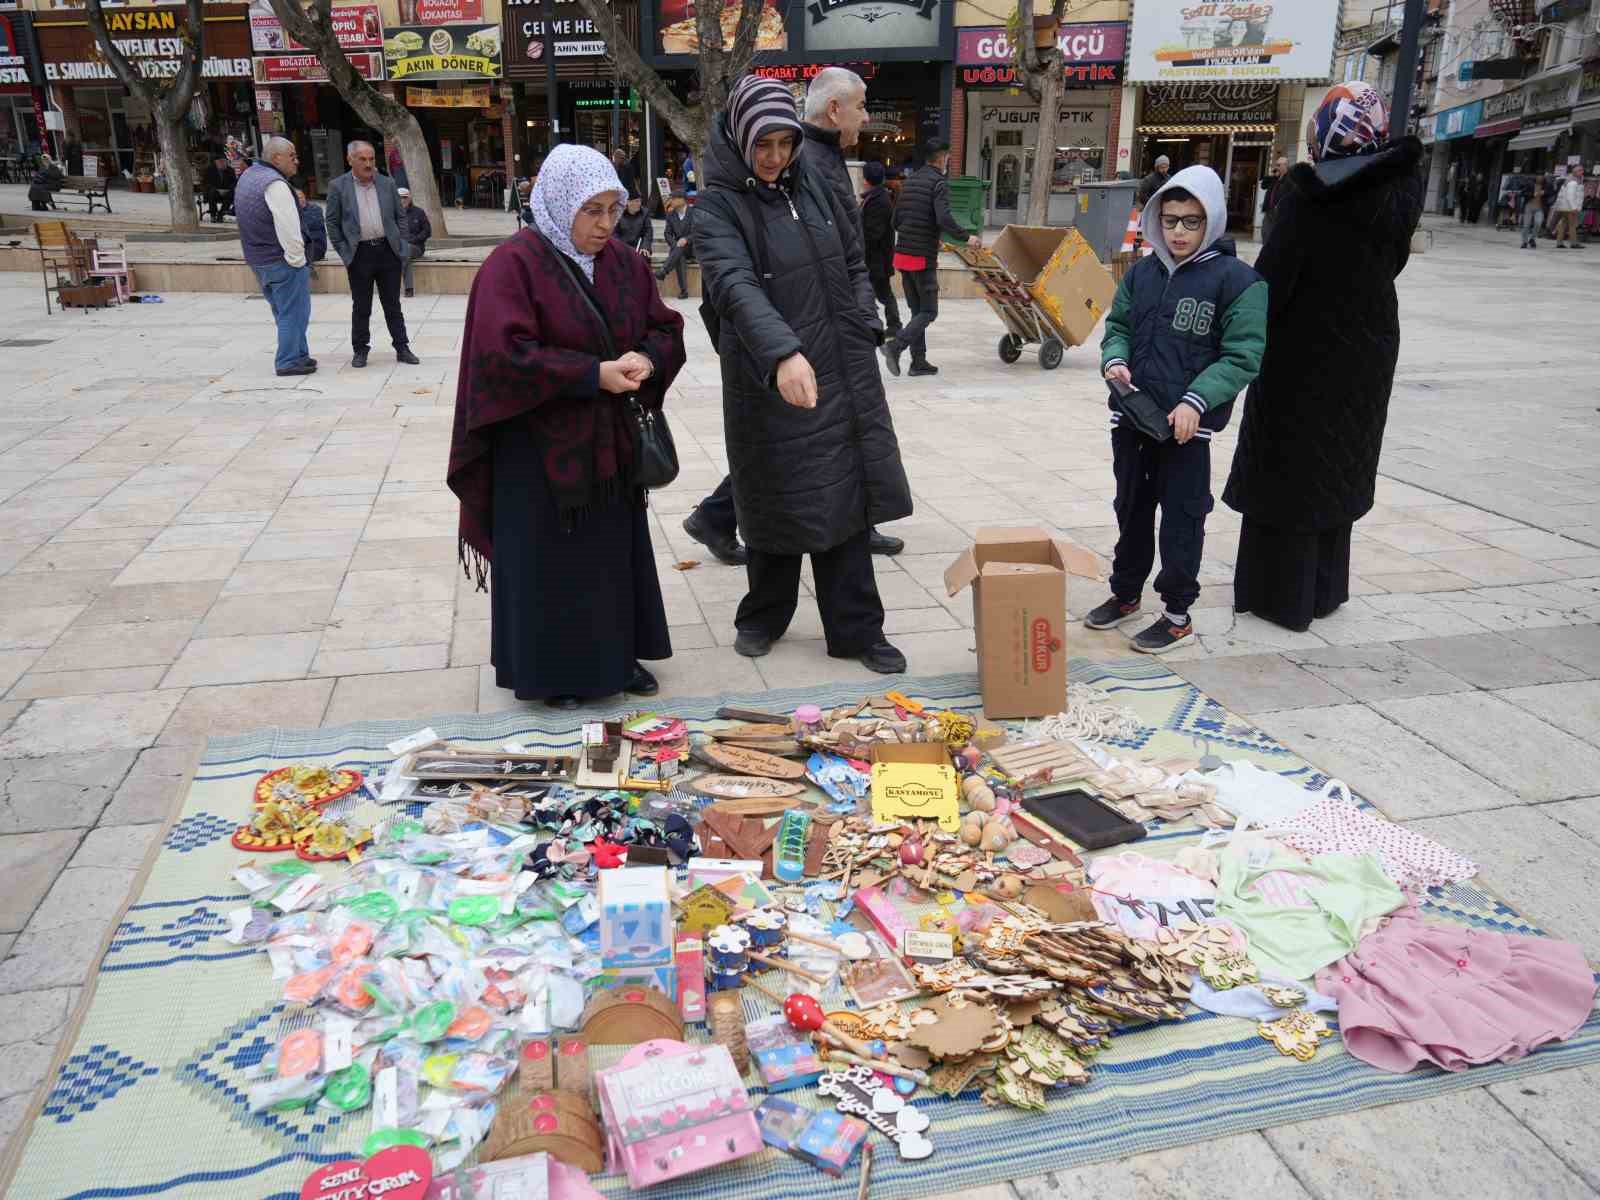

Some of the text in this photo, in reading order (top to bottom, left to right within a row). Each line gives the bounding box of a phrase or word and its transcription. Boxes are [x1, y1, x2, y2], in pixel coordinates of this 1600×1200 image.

[106, 12, 176, 31] AYSAN
[331, 20, 357, 32] ÖPRÜ
[158, 37, 184, 58] EŞY
[44, 64, 60, 80] EL
[61, 61, 118, 80] SANATLA
[201, 56, 251, 77] RÜNLER
[406, 56, 484, 73] AKIN DÖNER
[963, 63, 1117, 83] UĞU PTİK
[1058, 110, 1094, 123] PTİK
[1172, 297, 1216, 336] 86
